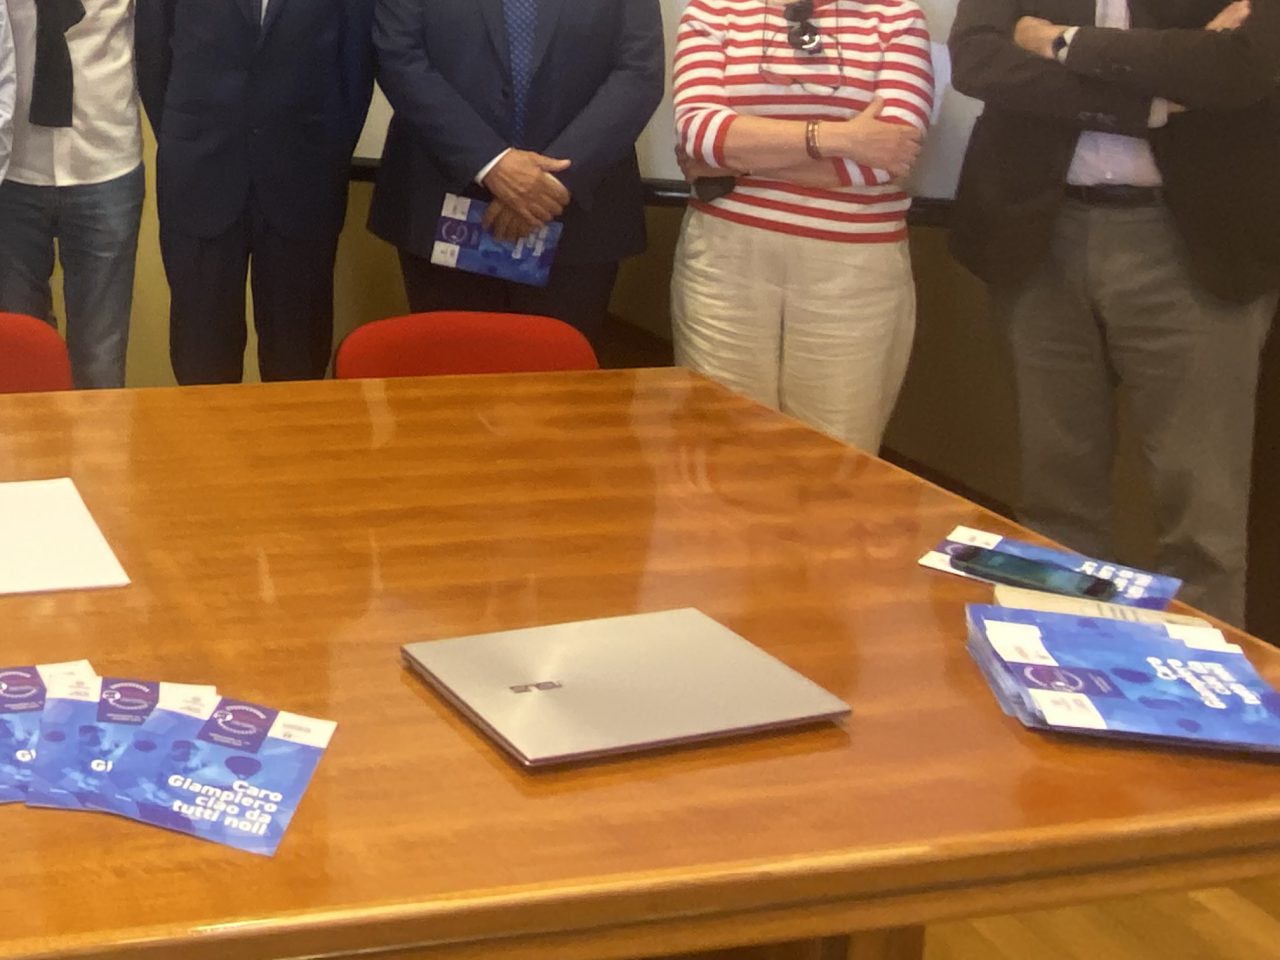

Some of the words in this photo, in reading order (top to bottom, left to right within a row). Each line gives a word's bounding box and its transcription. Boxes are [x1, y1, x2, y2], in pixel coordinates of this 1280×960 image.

[167, 774, 278, 813] Giampiero
[232, 780, 283, 802] Caro
[172, 799, 222, 822] tutti
[195, 796, 240, 815] ciao
